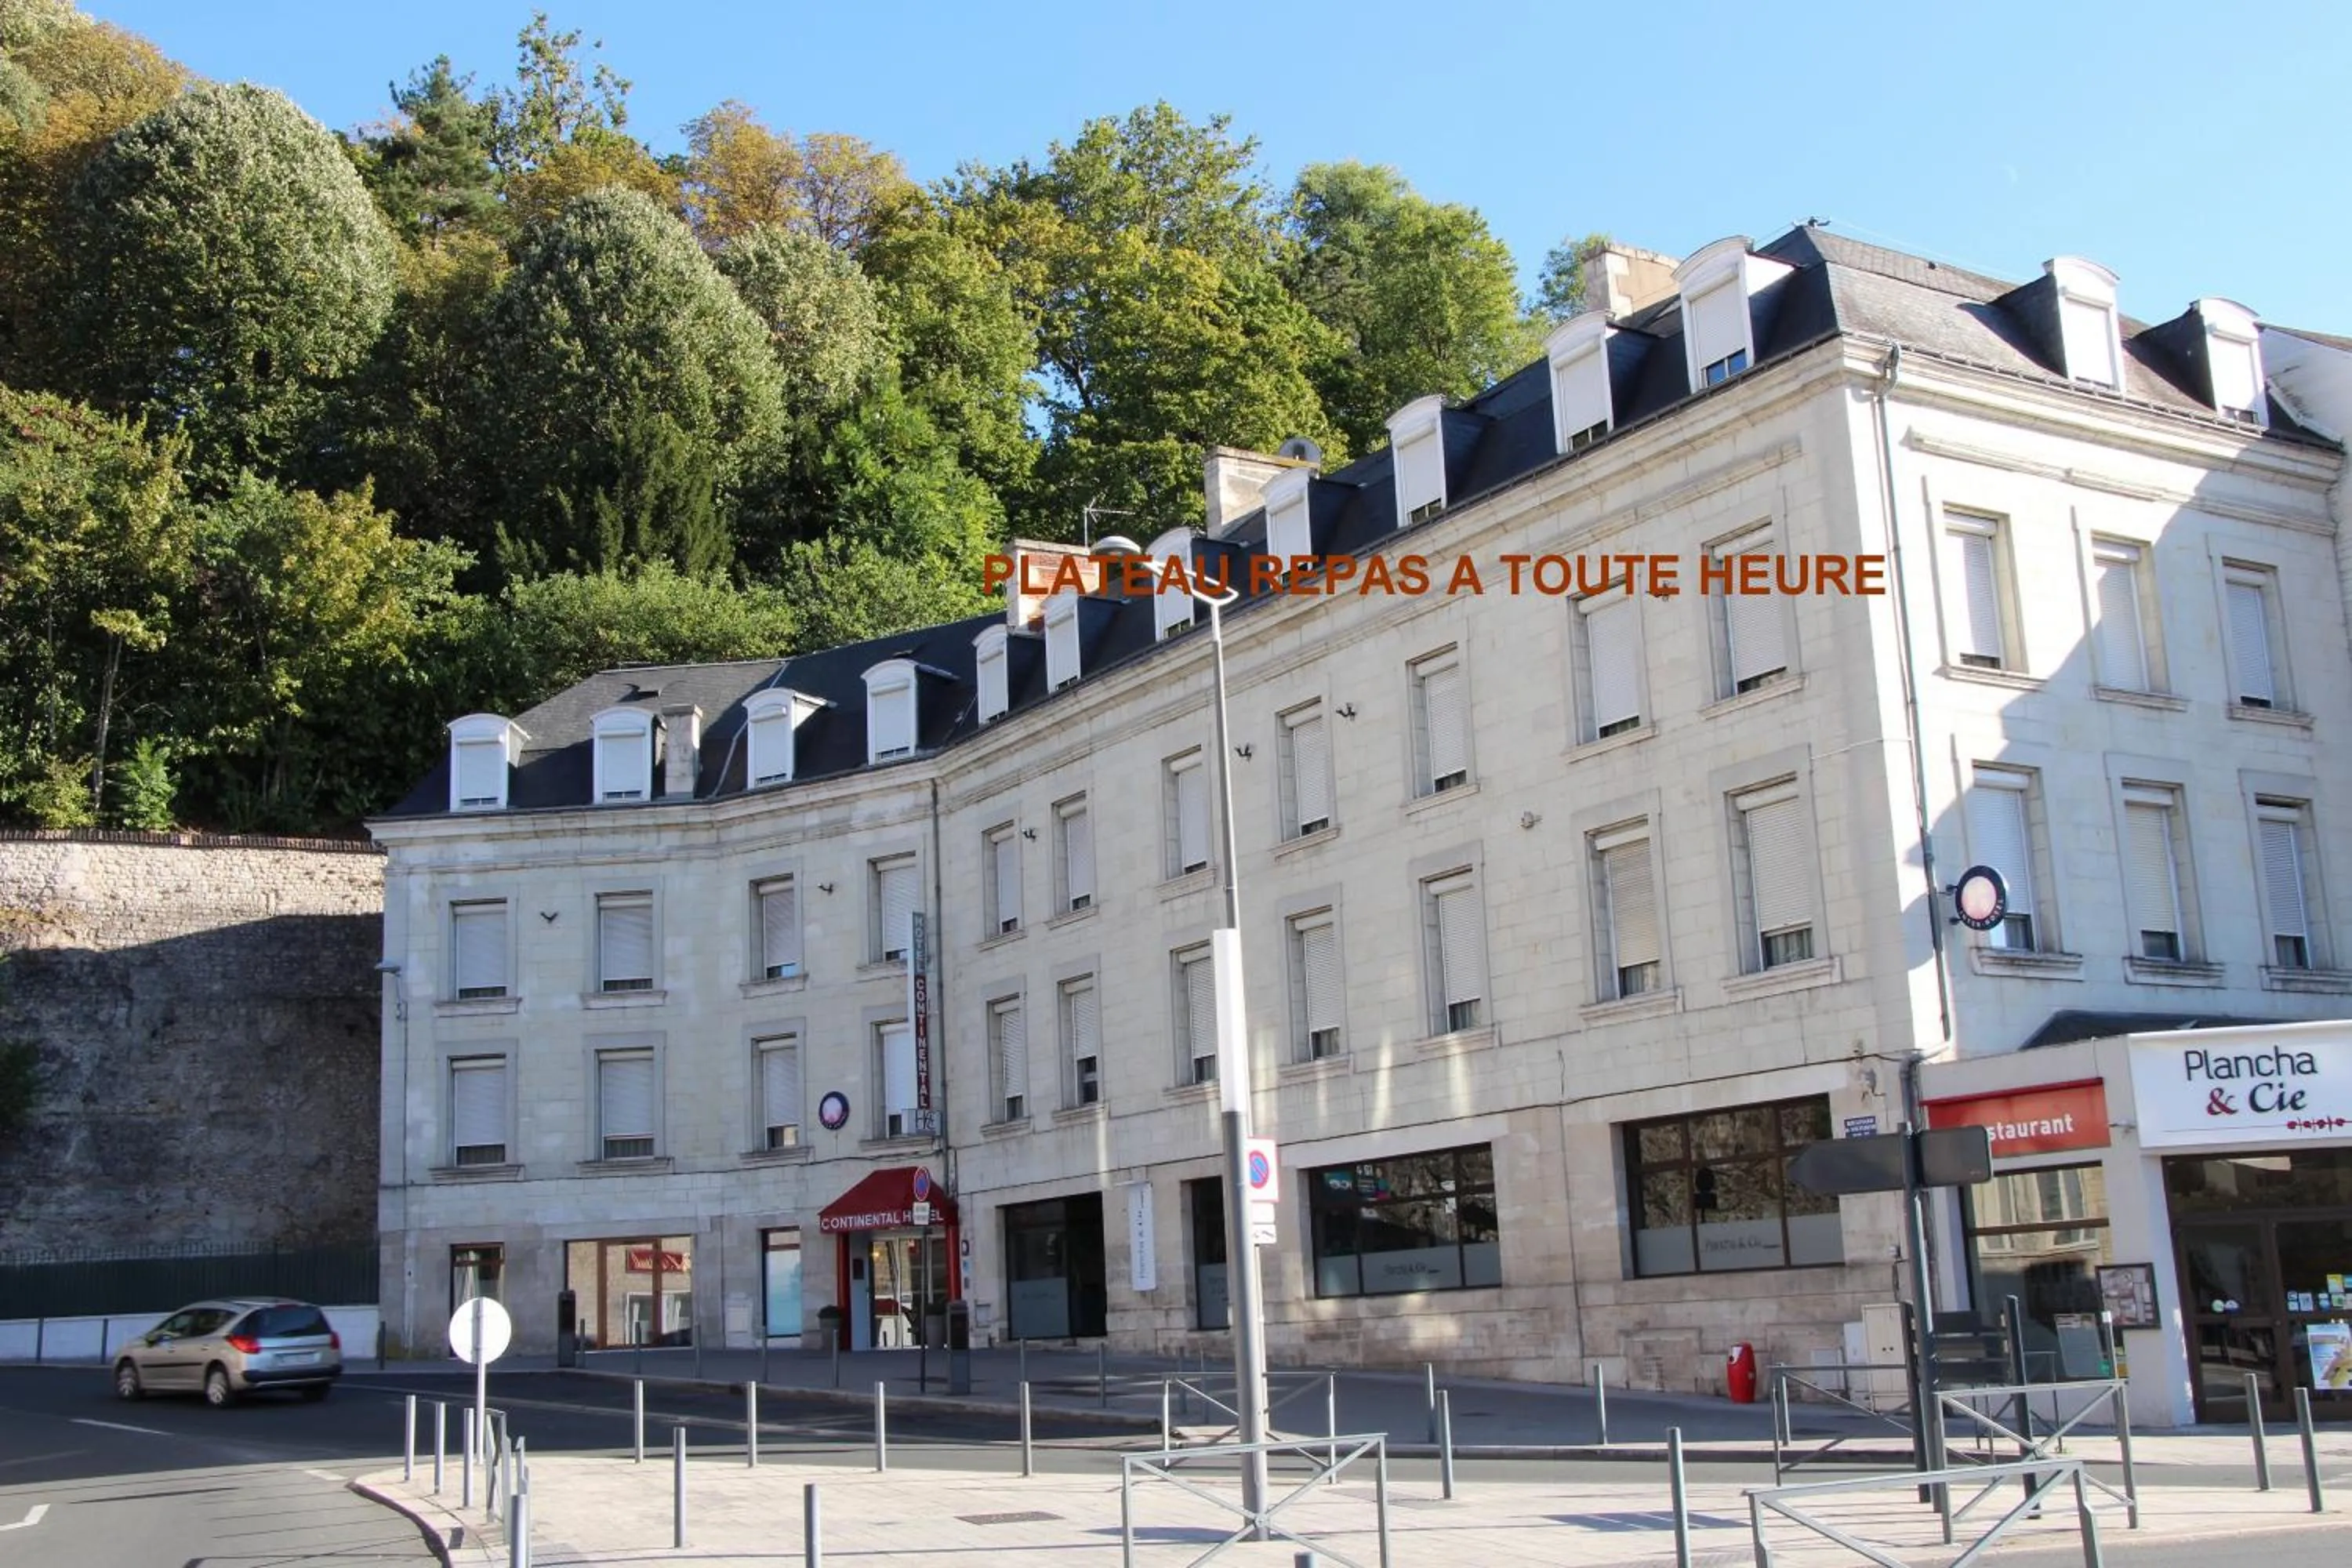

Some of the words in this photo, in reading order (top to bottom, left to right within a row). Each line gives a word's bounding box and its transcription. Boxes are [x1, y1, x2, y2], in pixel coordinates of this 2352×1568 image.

[916, 978, 928, 1107] CONTINENTAL
[2183, 1044, 2318, 1081] Plancha
[2206, 1087, 2239, 1116] &
[2248, 1081, 2308, 1113] Cie
[1986, 1113, 2074, 1142] staurant
[821, 1210, 900, 1230] CONTINENTAL
[902, 1209, 944, 1222] HEL
